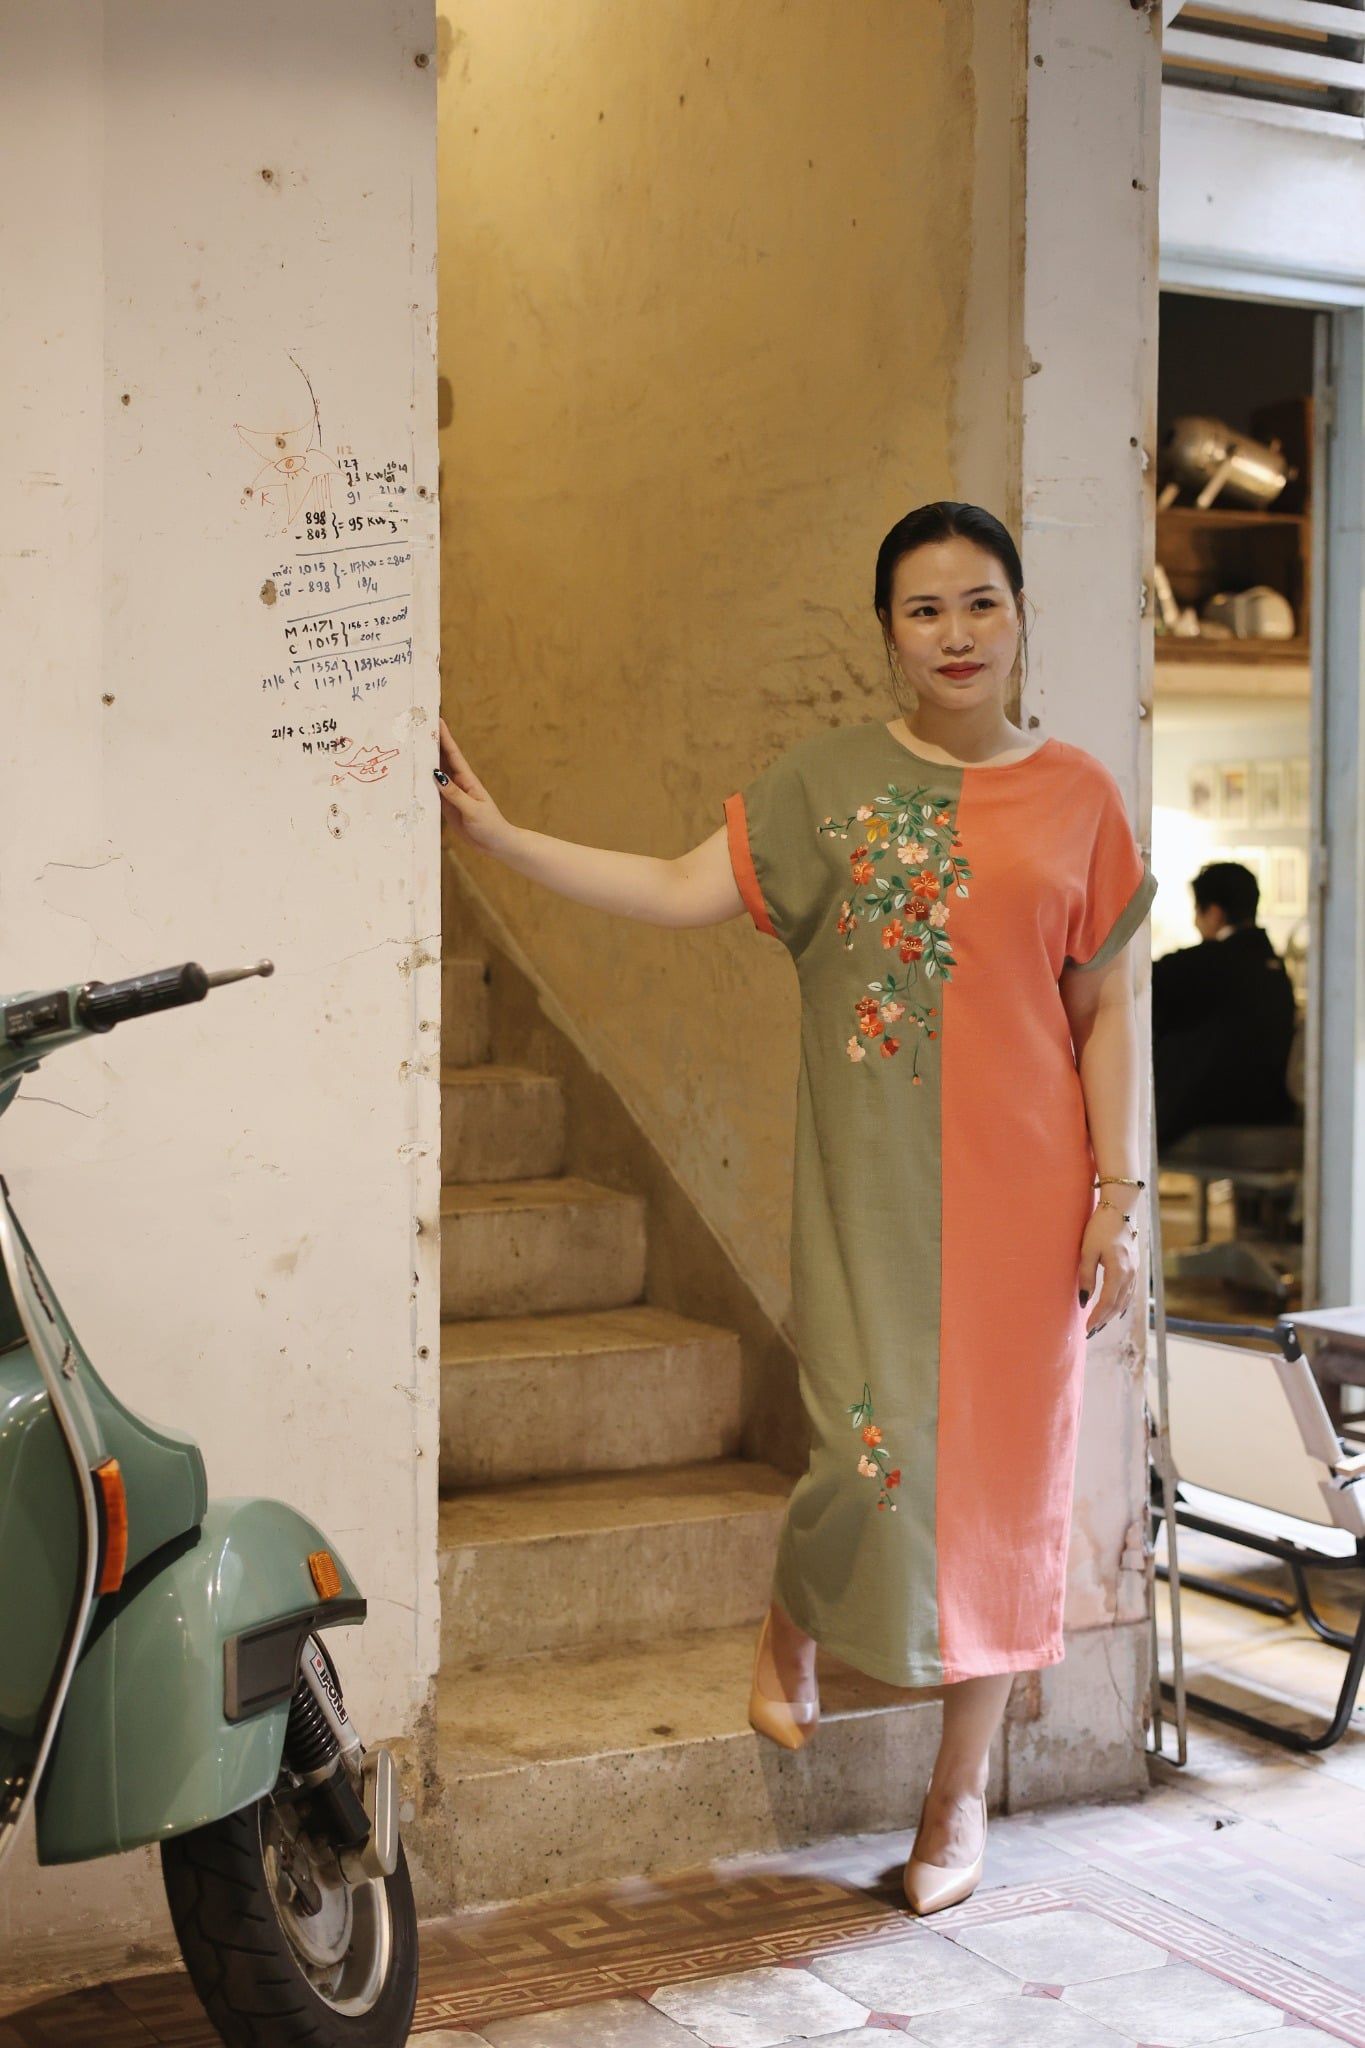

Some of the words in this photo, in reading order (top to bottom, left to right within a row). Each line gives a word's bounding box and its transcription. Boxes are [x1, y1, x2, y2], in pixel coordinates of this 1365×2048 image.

[337, 458, 359, 472] 127
[346, 491, 361, 505] 91
[305, 510, 327, 525] 898
[348, 516, 364, 532] 95
[306, 528, 328, 541] 803
[308, 580, 331, 594] 898
[284, 625, 298, 640] M
[314, 675, 342, 691] 1171
[271, 725, 294, 740] 21/7
[302, 741, 313, 755] M
[319, 1668, 348, 1721] IPONE
